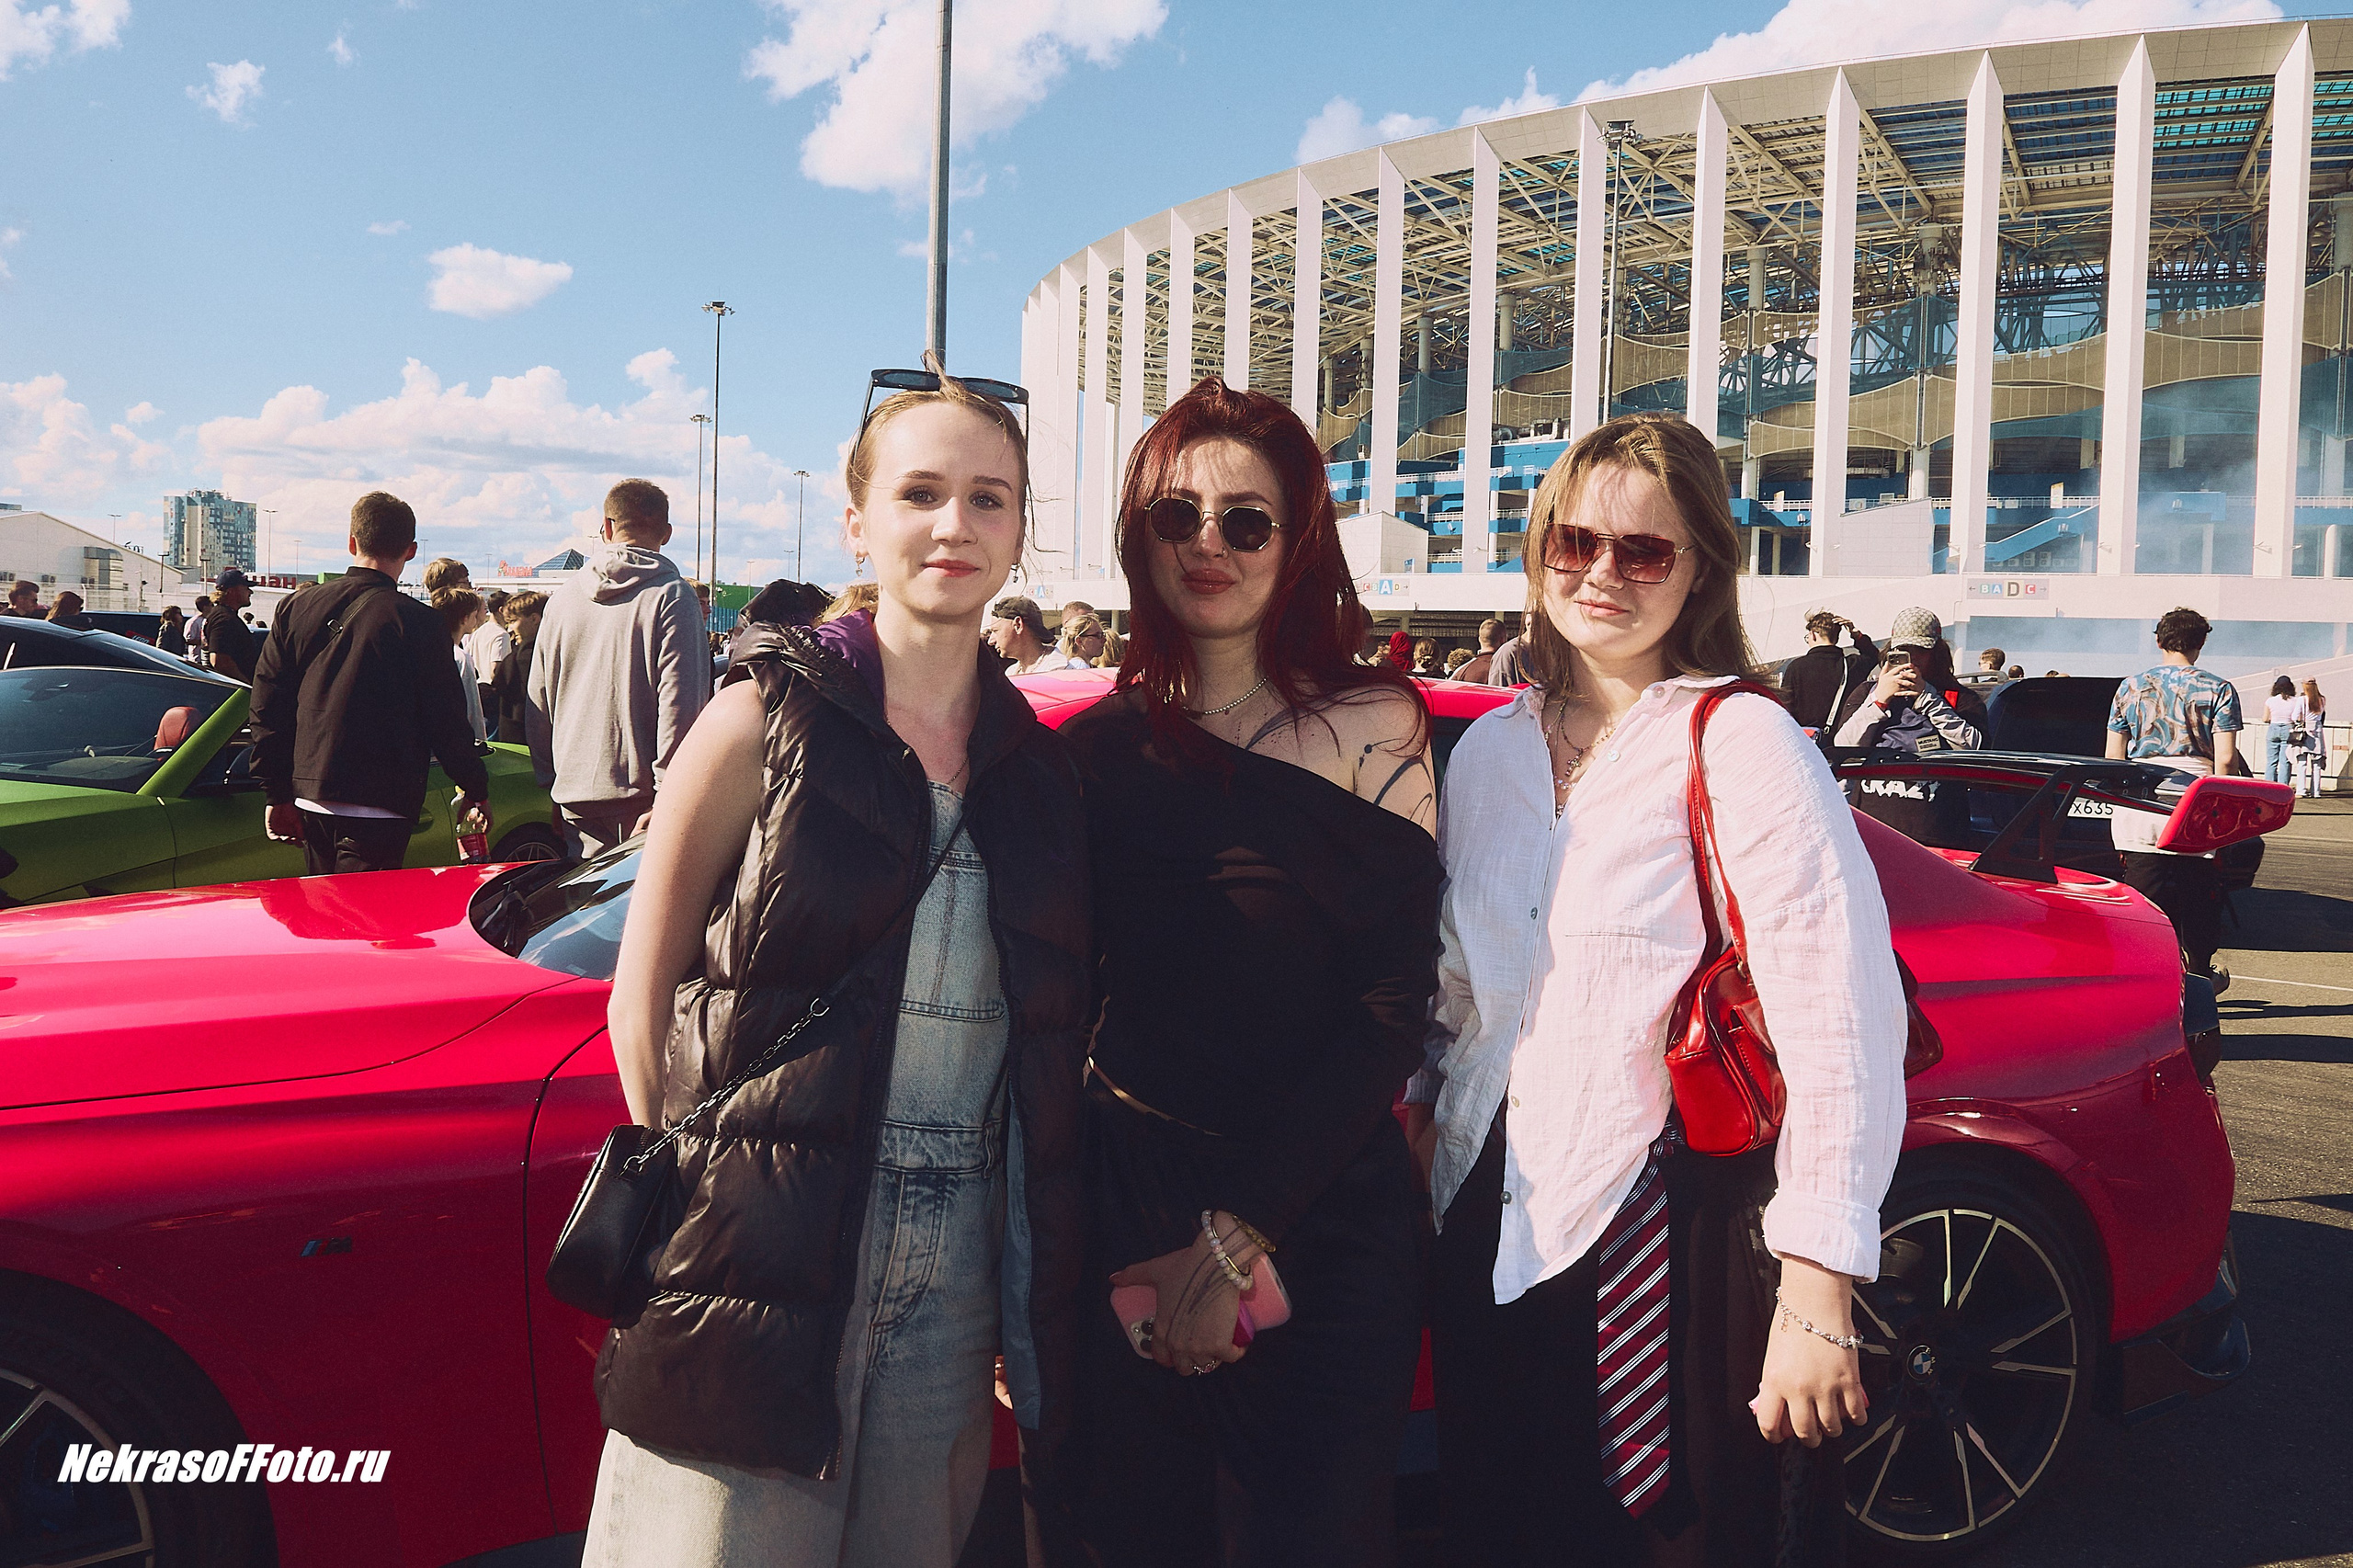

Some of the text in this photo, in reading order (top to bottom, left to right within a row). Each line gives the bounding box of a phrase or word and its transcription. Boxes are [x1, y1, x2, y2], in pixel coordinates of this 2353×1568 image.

[1380, 580, 1392, 595] A
[1981, 582, 2035, 597] B A D C
